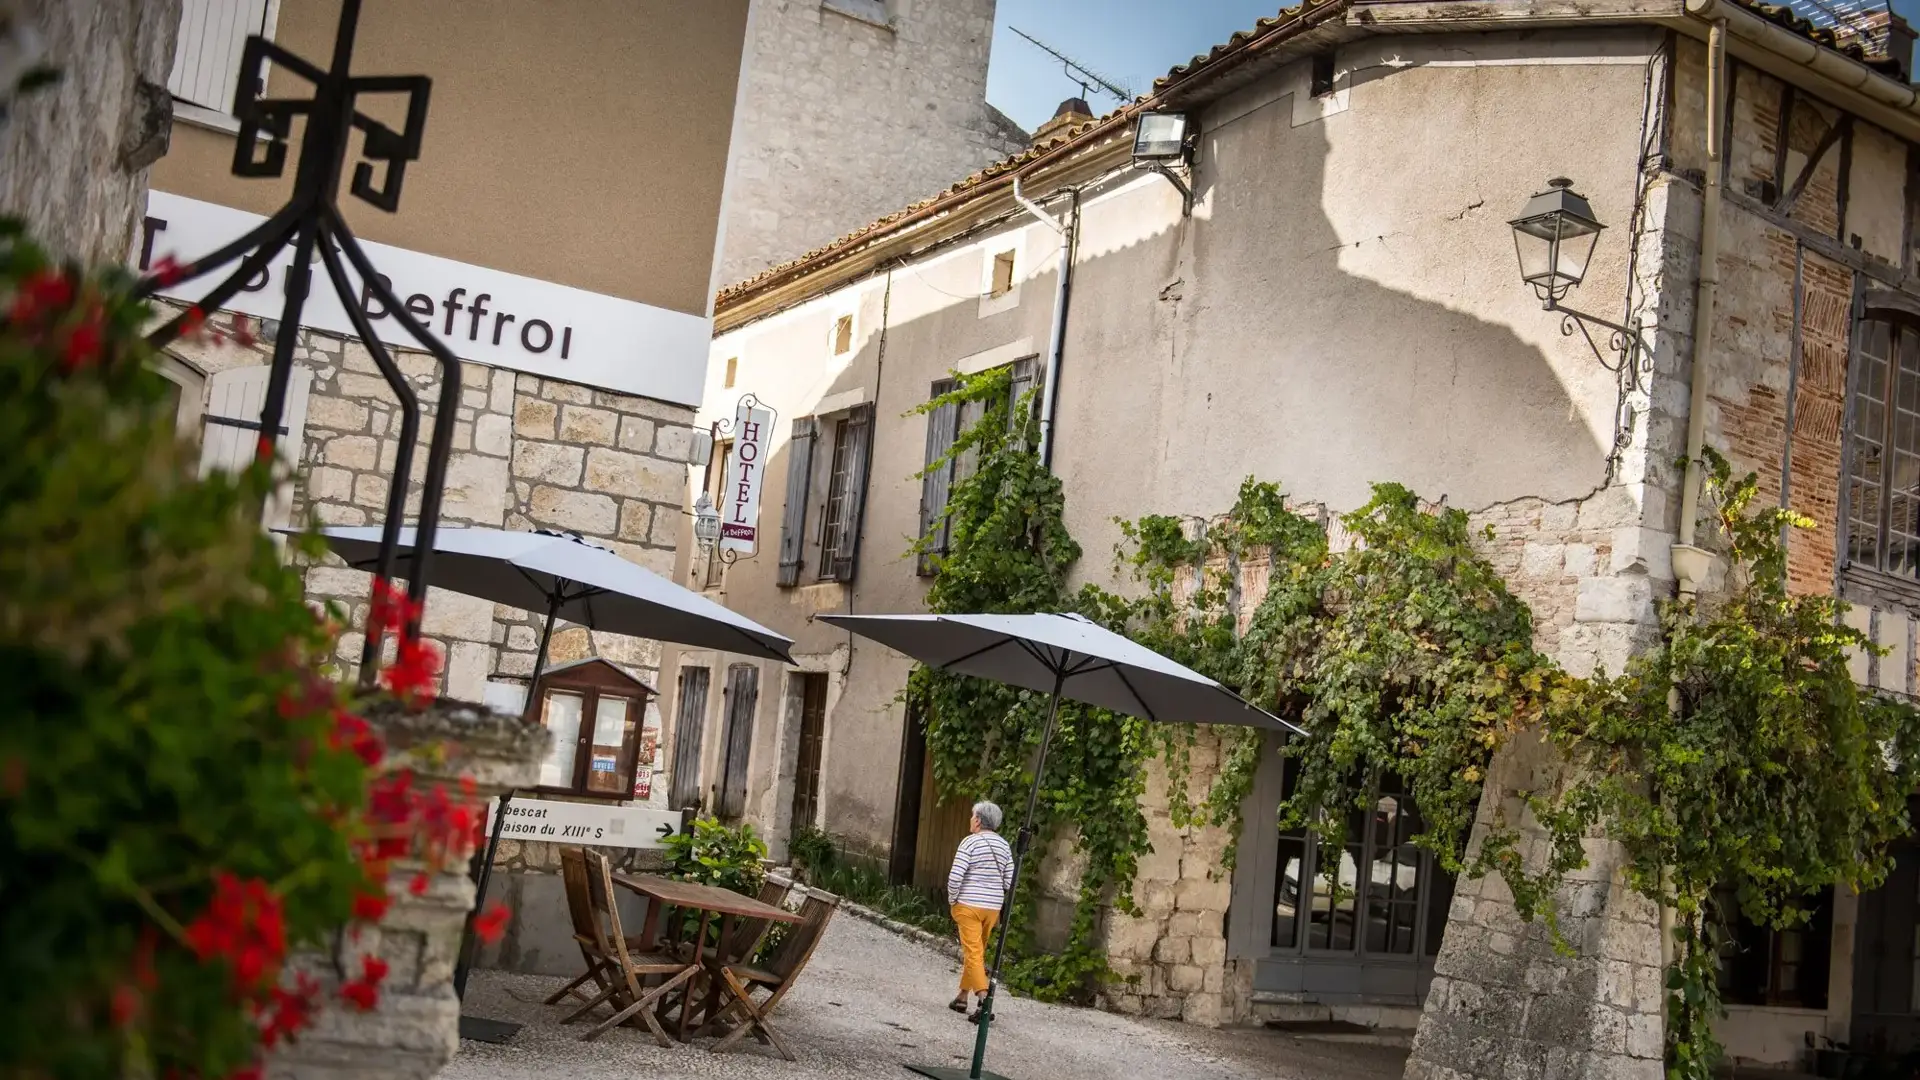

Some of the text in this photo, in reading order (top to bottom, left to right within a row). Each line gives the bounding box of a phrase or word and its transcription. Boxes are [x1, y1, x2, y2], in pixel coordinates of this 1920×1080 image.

[361, 272, 573, 360] Beffroi
[733, 421, 760, 523] HOTEL
[499, 820, 537, 835] aison
[540, 823, 556, 836] du
[594, 827, 604, 839] S
